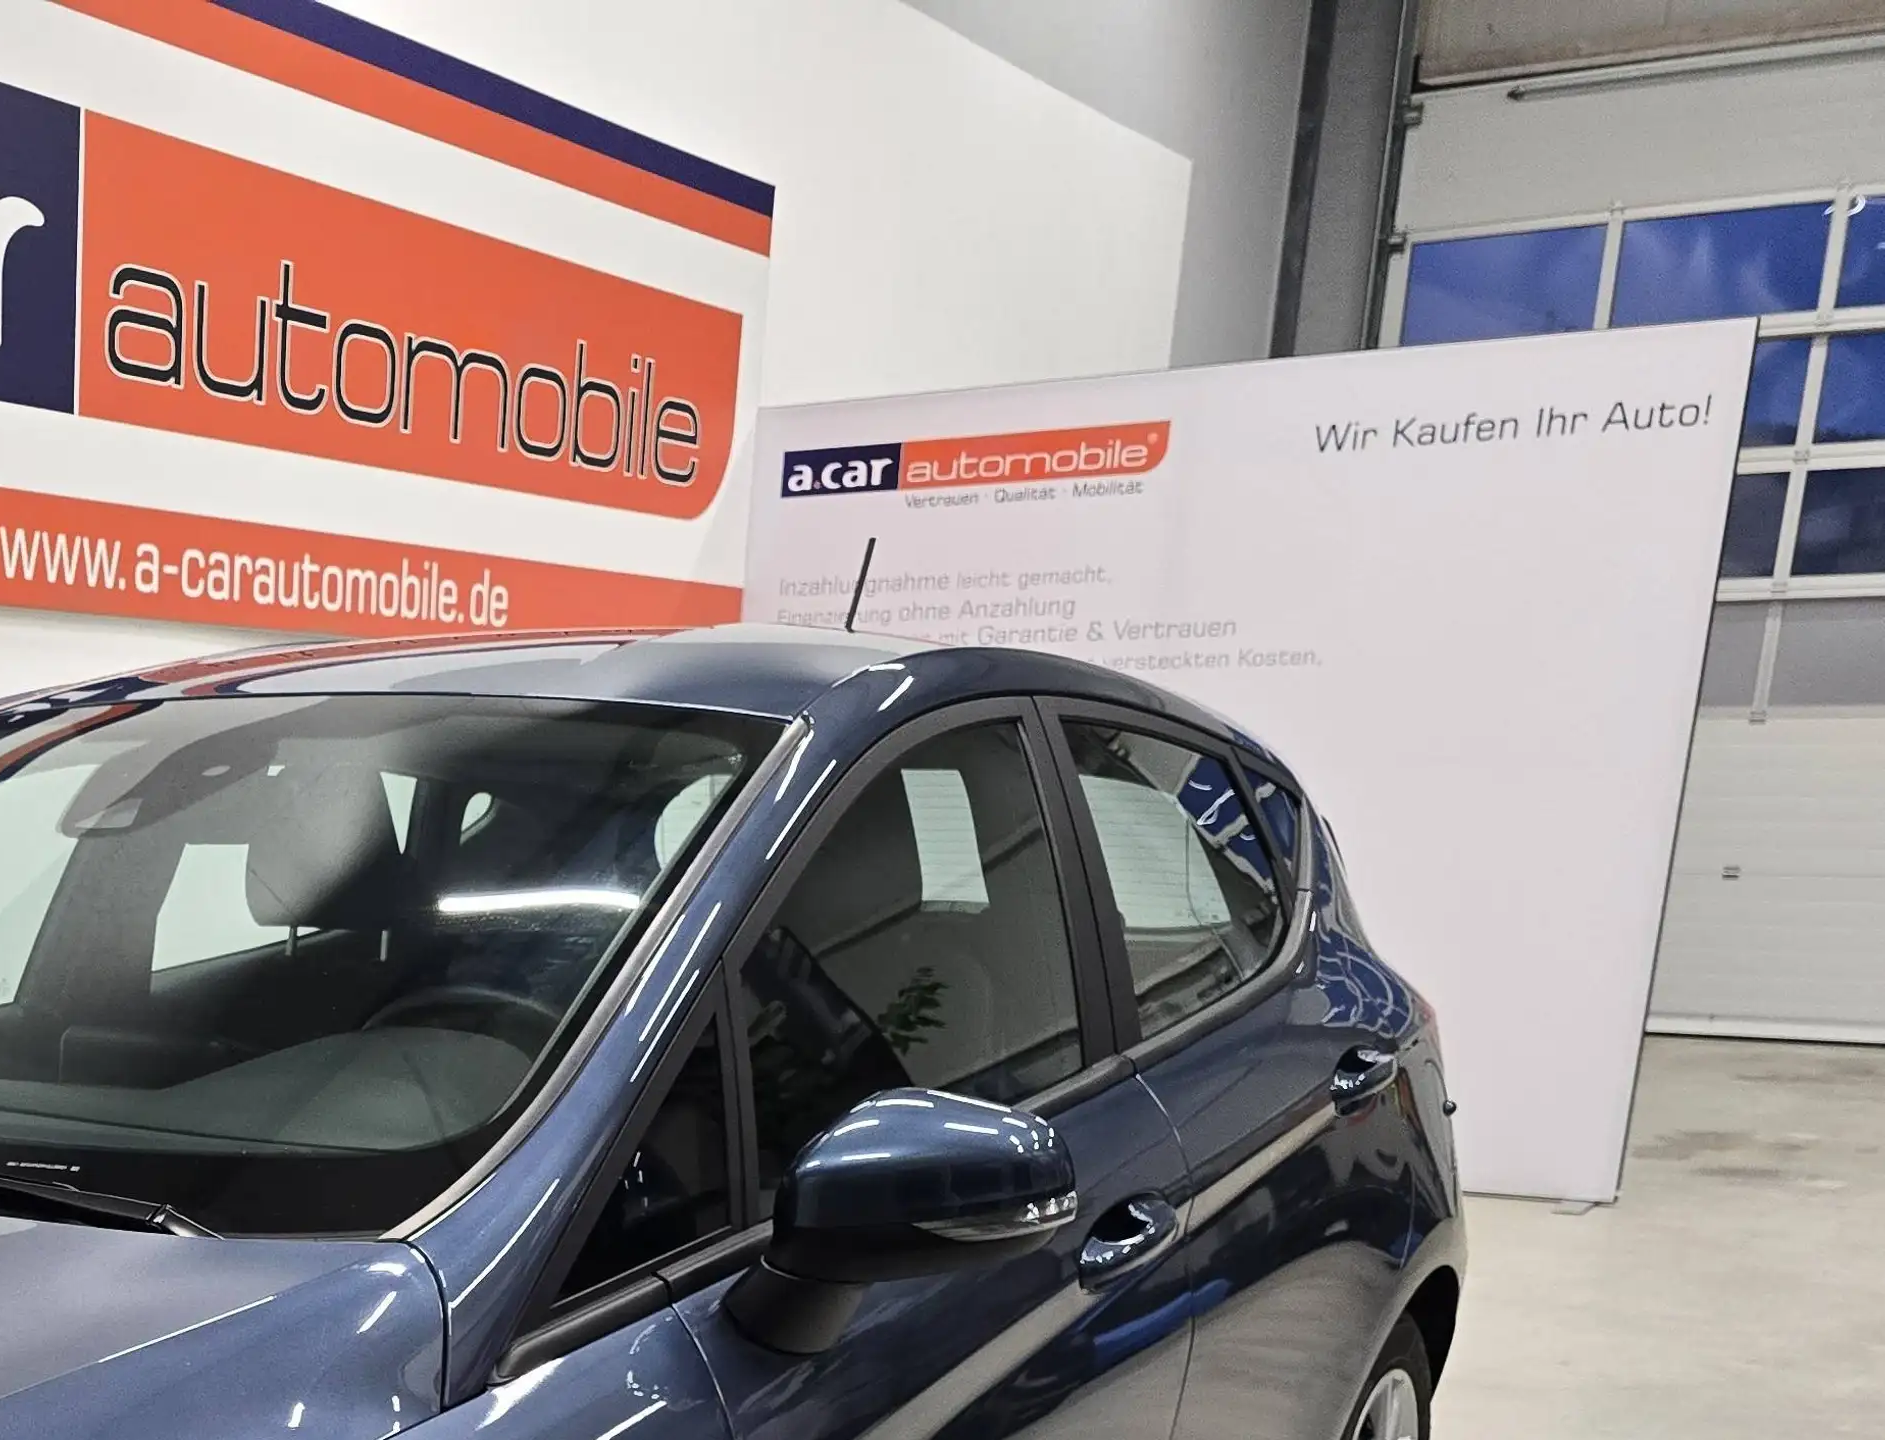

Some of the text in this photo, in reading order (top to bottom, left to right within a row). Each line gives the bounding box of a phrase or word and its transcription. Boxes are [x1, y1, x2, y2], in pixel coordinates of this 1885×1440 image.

[107, 260, 700, 487] automobile
[1315, 394, 1713, 453] Wir Kaufen Ihr Auto!
[787, 457, 894, 492] a.car
[904, 491, 980, 509] Vertrauen
[0, 525, 511, 629] www.a-carautomobile.de
[779, 572, 950, 598] Inzahlugnahme
[956, 569, 1012, 590] leicht
[898, 601, 952, 622] ohne
[957, 596, 1076, 621] Anzahlung
[976, 623, 1079, 648] Garantie
[1085, 620, 1104, 642] &
[1113, 618, 1238, 641] Vertrauen
